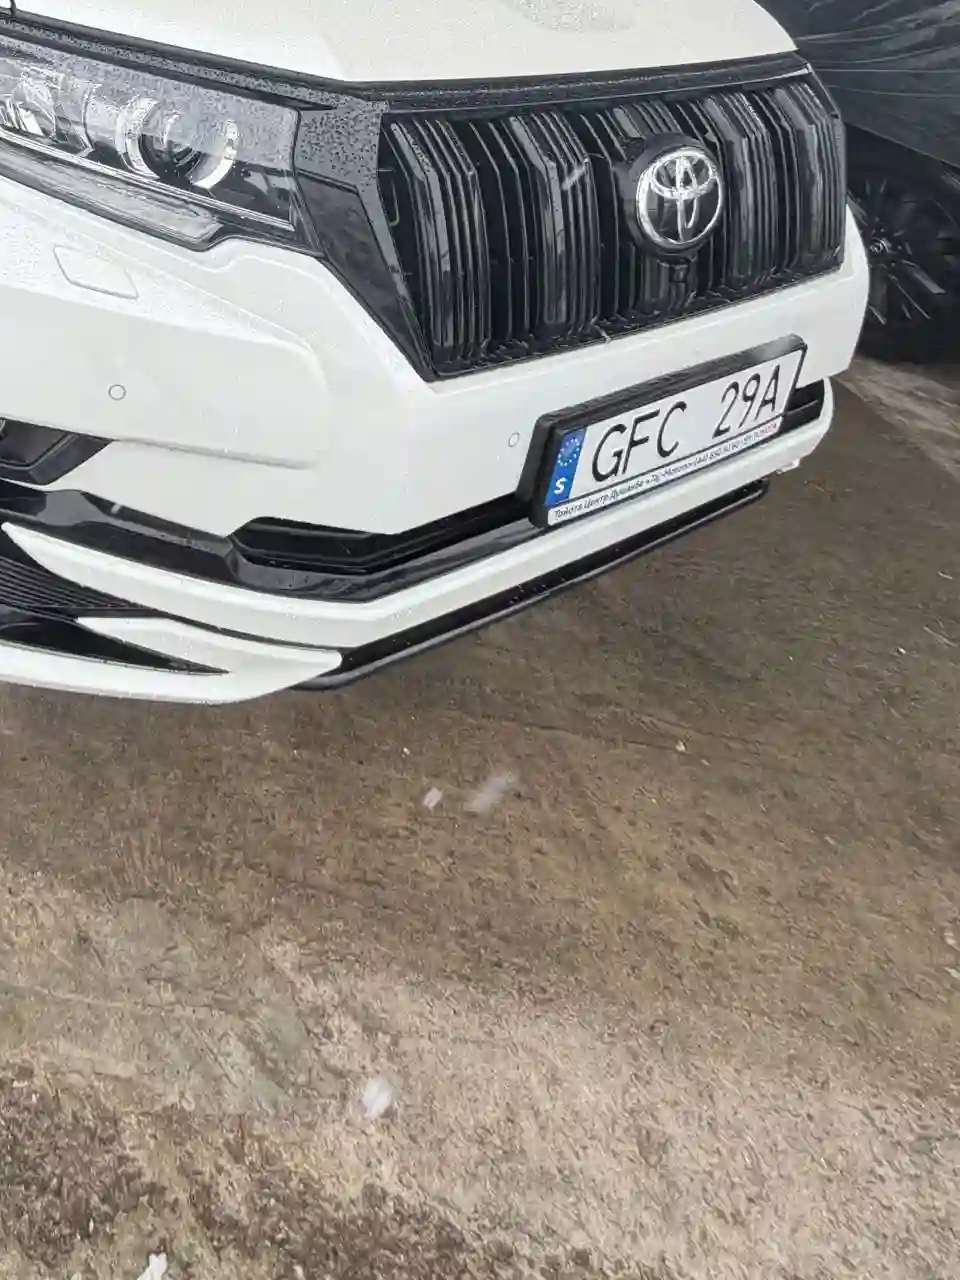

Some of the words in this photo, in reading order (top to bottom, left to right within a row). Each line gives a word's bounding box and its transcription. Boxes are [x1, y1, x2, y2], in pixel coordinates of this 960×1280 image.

[592, 400, 687, 483] GFC
[712, 364, 781, 440] 29A
[553, 477, 567, 495] S
